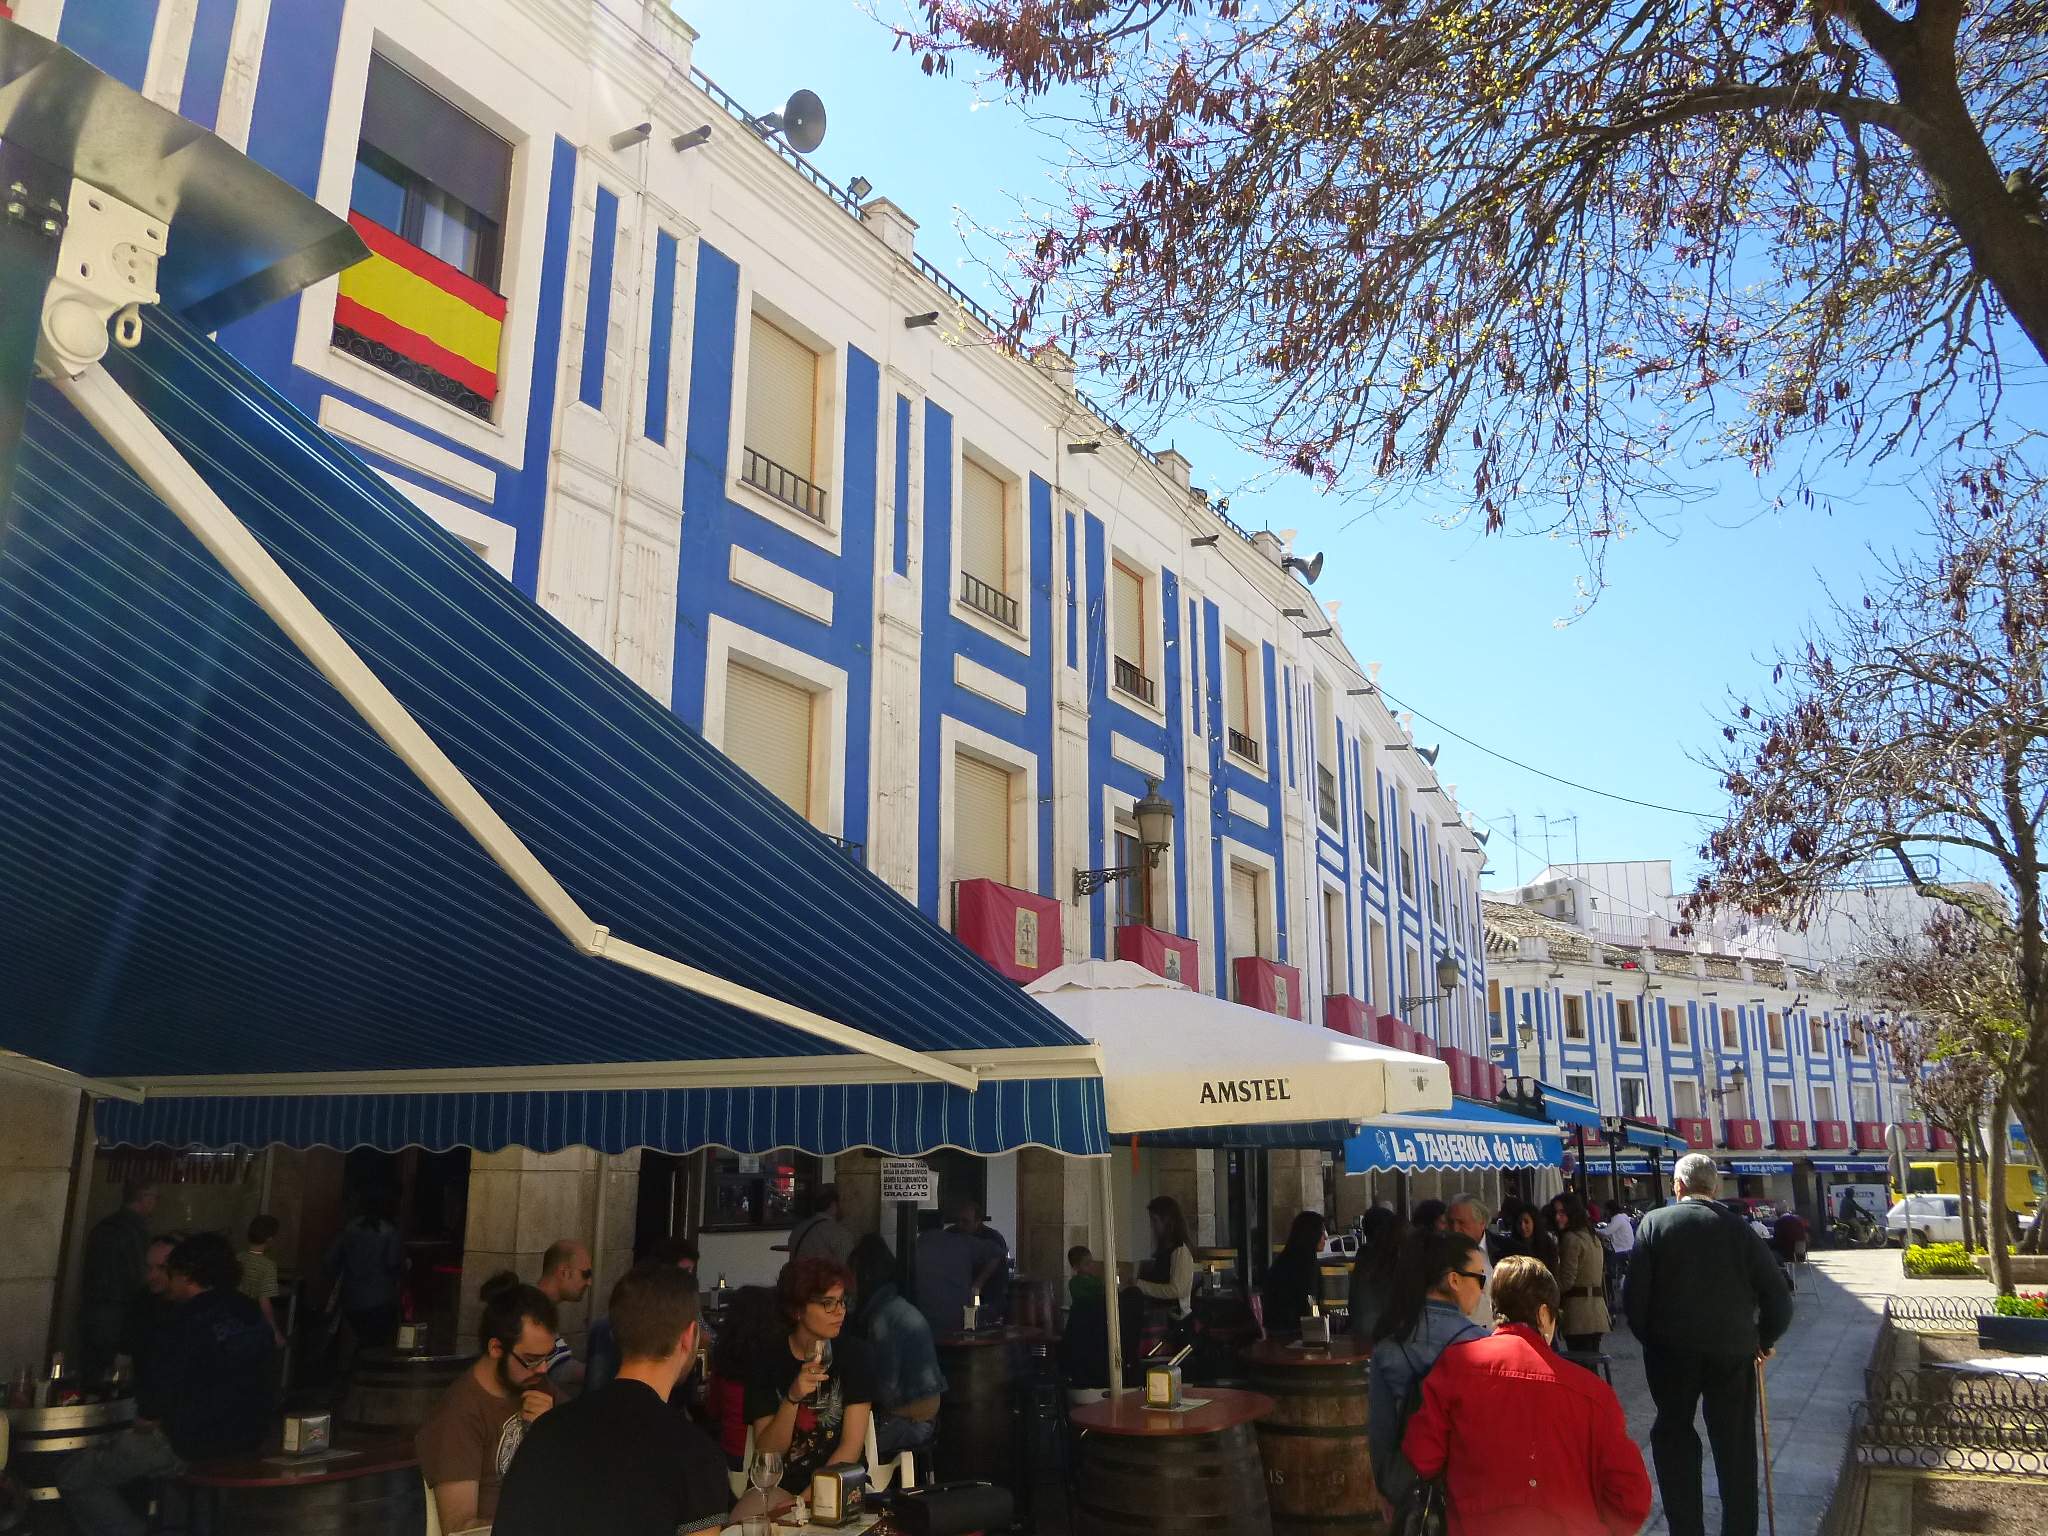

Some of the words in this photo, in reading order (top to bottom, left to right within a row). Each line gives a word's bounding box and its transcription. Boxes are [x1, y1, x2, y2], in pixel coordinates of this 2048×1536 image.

[1199, 1078, 1291, 1104] AMSTEL
[1389, 1131, 1418, 1162] La
[1413, 1133, 1493, 1162] TABERNA
[1493, 1135, 1510, 1162] de
[1510, 1136, 1538, 1162] Iván
